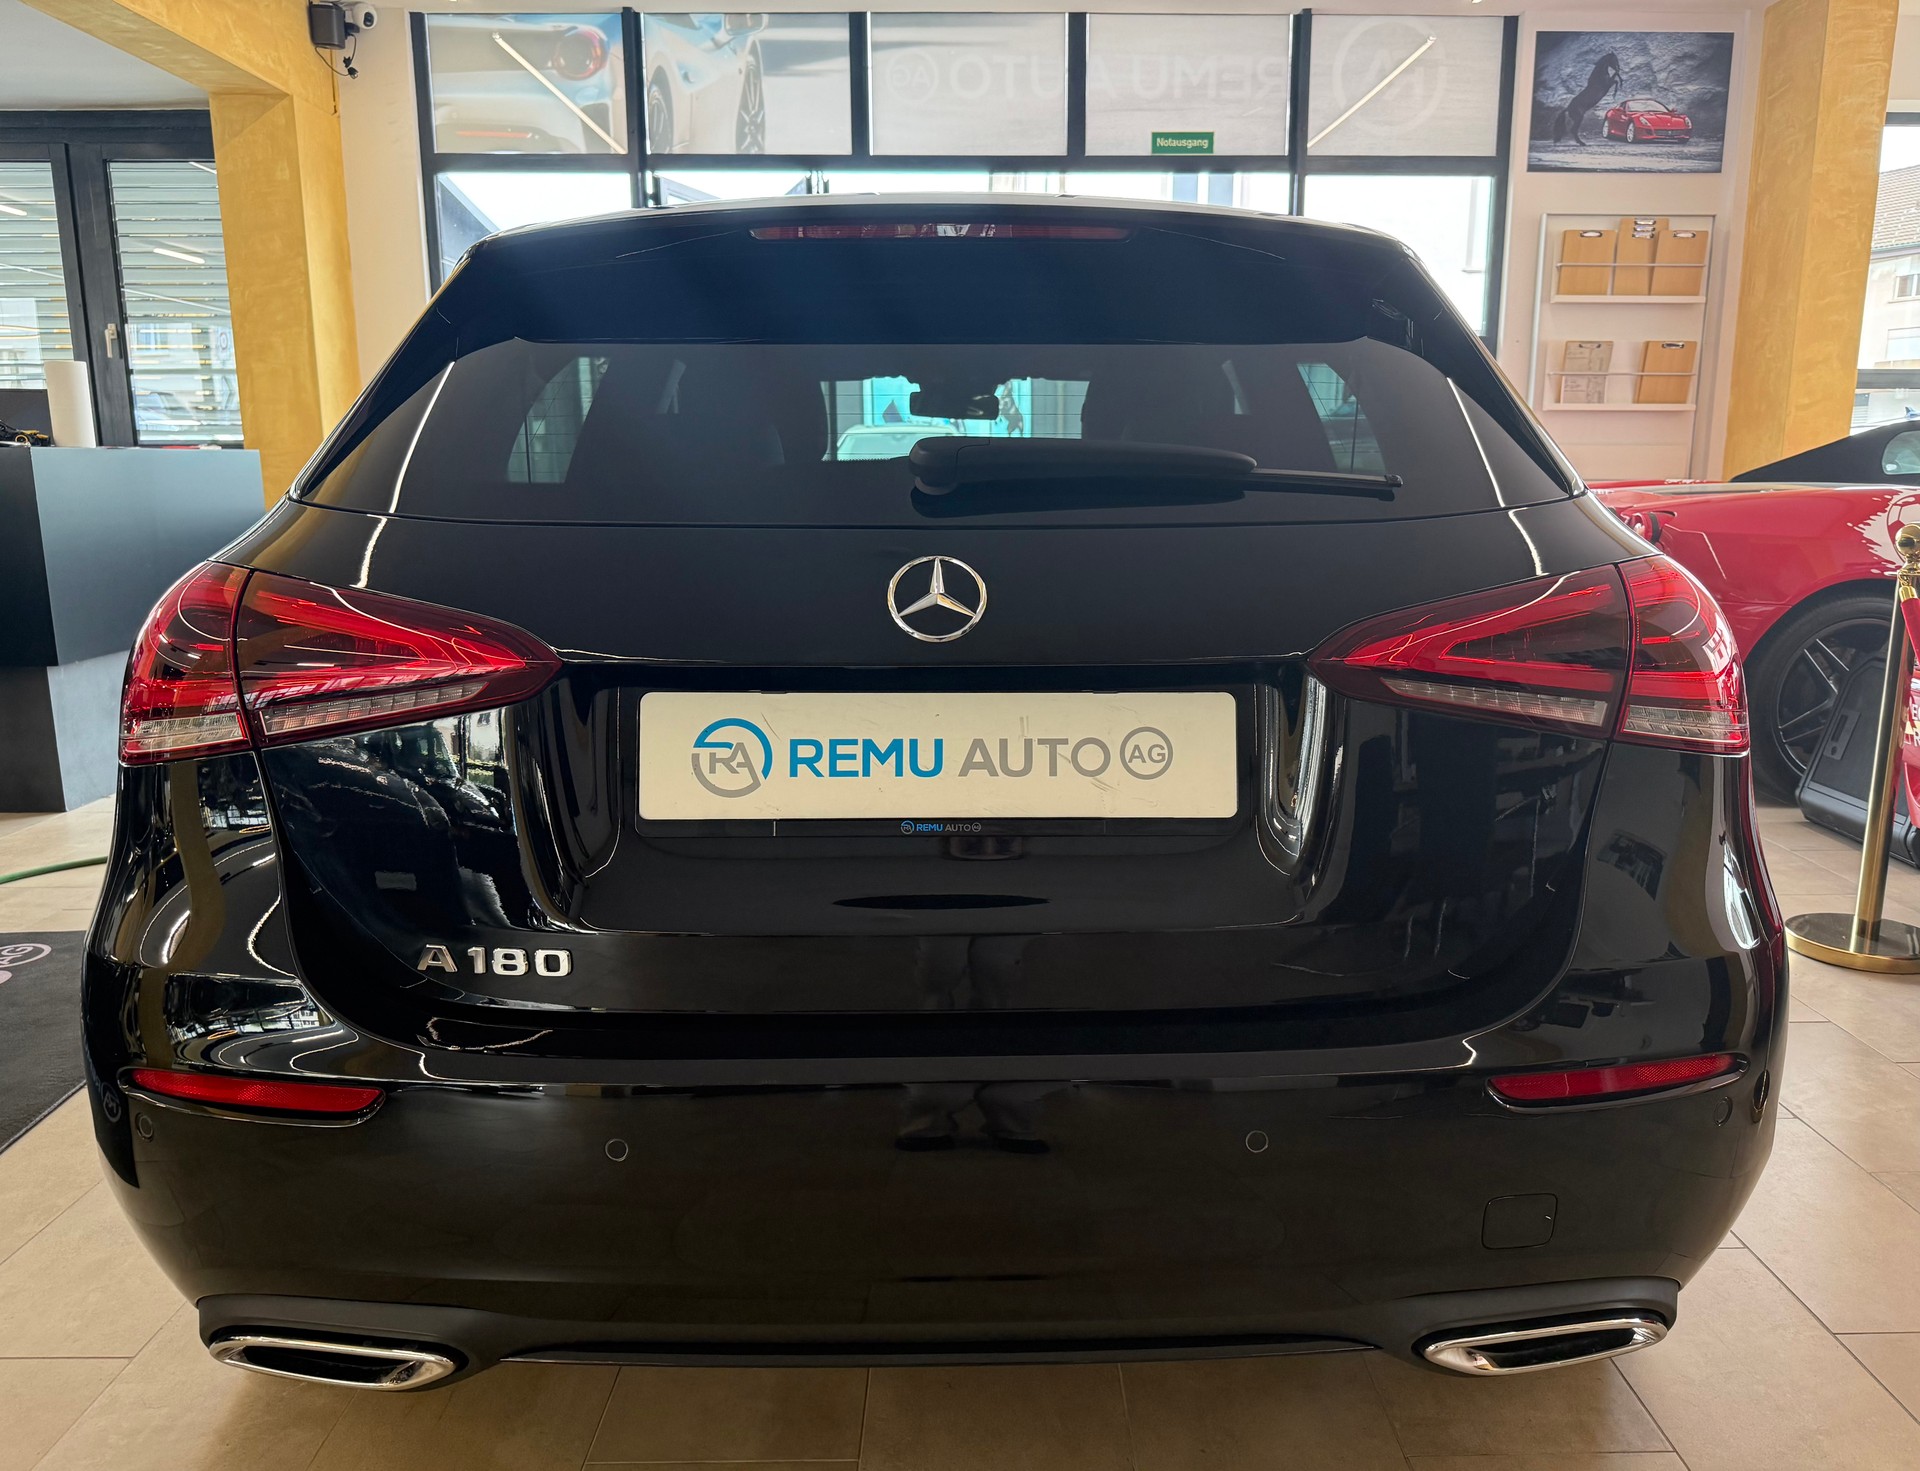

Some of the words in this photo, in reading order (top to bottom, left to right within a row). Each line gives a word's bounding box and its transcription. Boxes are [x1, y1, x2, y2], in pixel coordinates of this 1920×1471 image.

[1156, 137, 1209, 149] Notausgang
[789, 738, 944, 778] REMU
[957, 737, 1111, 778] AUTO
[916, 823, 943, 832] REMU
[945, 823, 971, 832] AUTO
[417, 944, 458, 973] A
[467, 946, 572, 977] 180
